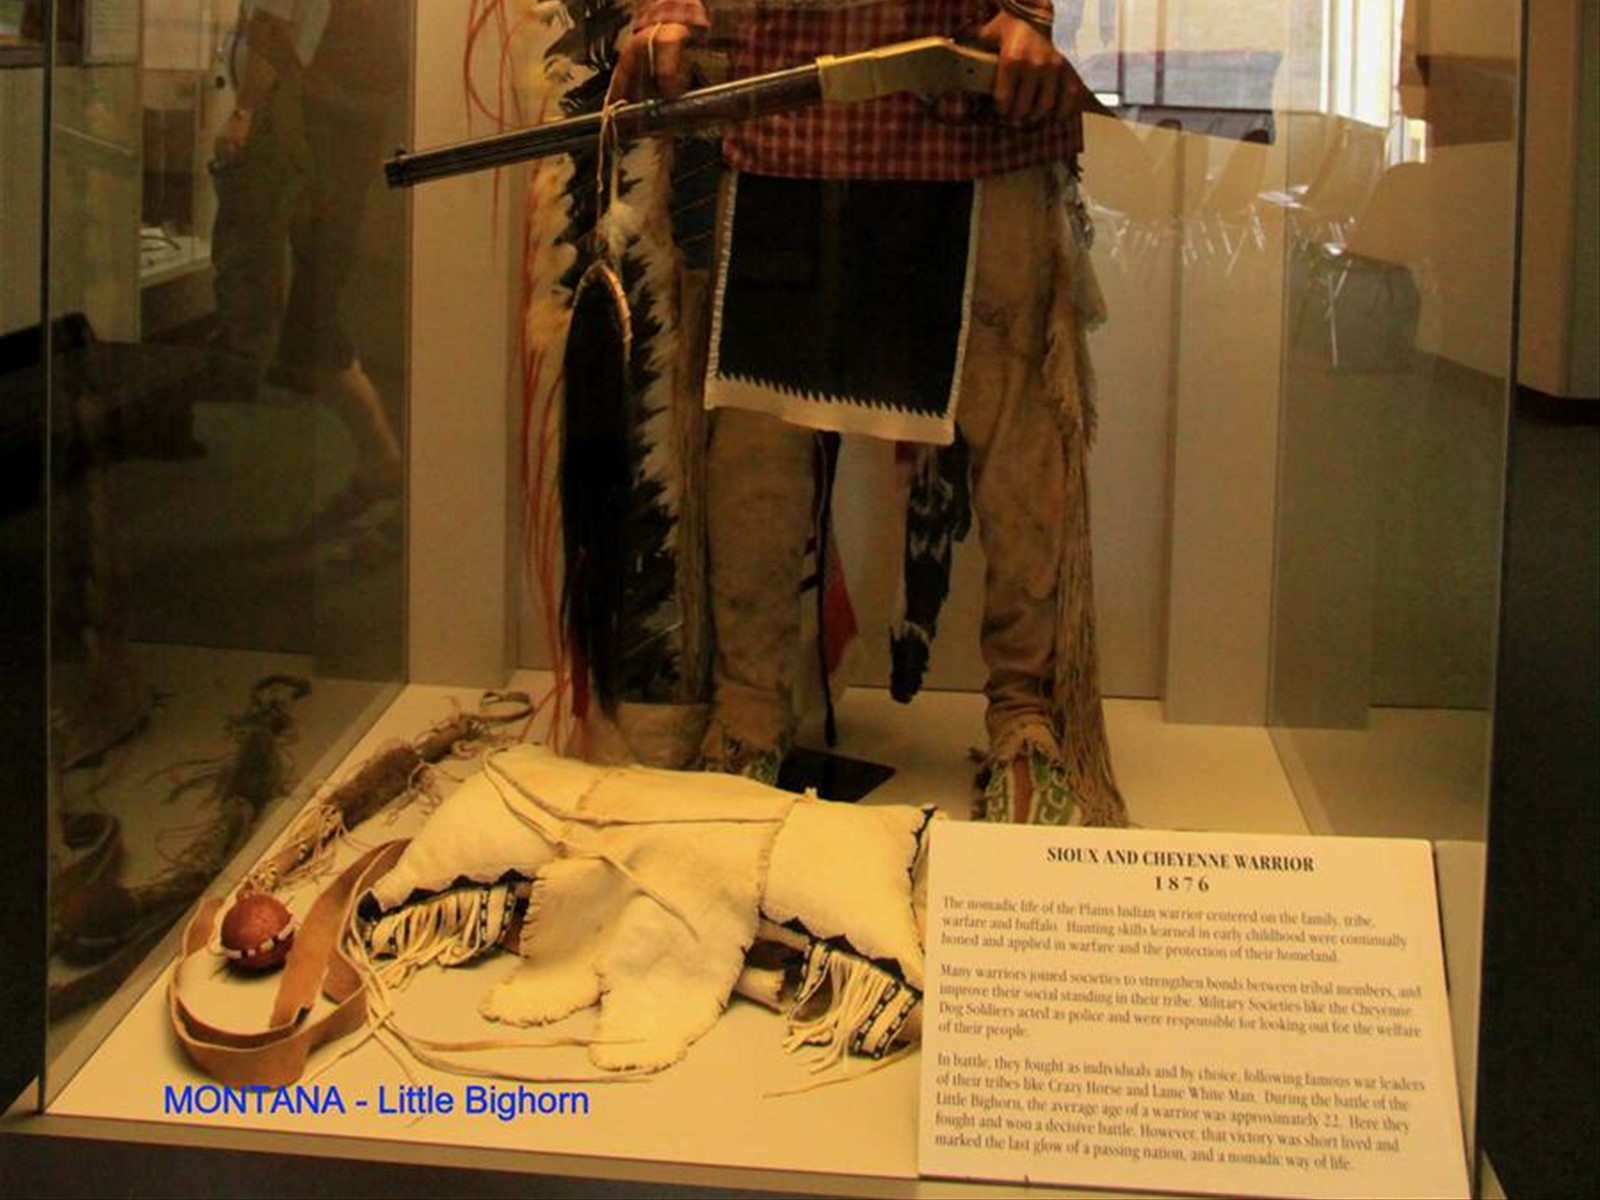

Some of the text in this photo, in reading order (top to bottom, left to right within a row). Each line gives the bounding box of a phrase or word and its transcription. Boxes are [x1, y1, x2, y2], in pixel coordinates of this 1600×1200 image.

[1047, 847, 1315, 872] SIOUX AND CHEYENNE WARRIOR
[1155, 875, 1209, 892] 1876
[1042, 900, 1055, 913] of
[1057, 902, 1075, 915] the
[1280, 911, 1298, 924] the
[990, 916, 1012, 929] and
[982, 933, 1006, 948] and
[1119, 941, 1140, 954] and
[1142, 942, 1162, 955] the
[1229, 945, 1243, 958] of
[1398, 985, 1422, 999] and
[1329, 1001, 1348, 1015] the
[938, 1020, 952, 1033] of
[1107, 1010, 1131, 1023] and
[1353, 1022, 1373, 1035] the
[1154, 1065, 1177, 1078] and
[936, 1072, 951, 1086] of
[1125, 1082, 1149, 1096] and
[1310, 1093, 1333, 1106] the
[1372, 1096, 1387, 1110] of
[1388, 1098, 1408, 1111] the
[1027, 1098, 1048, 1112] the
[1125, 1102, 1139, 1115] of
[978, 1113, 1002, 1128] and
[1375, 1137, 1399, 1151] and
[984, 1133, 1007, 1148] the
[1065, 1138, 1080, 1152] of
[1190, 1148, 1214, 1161] and
[1313, 1155, 1327, 1168] of
